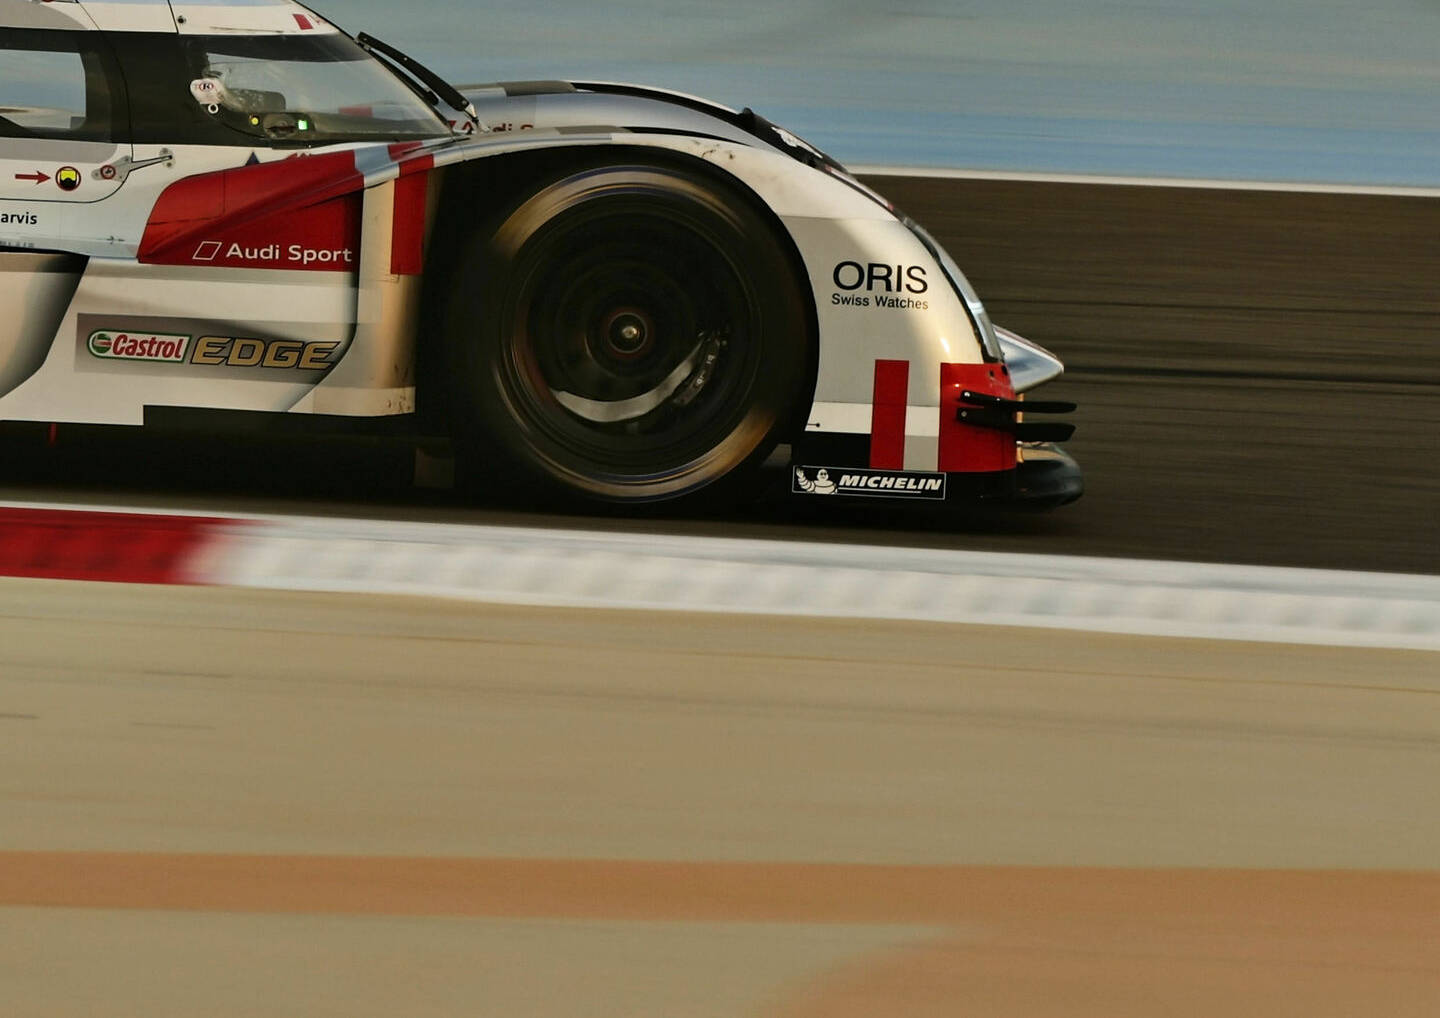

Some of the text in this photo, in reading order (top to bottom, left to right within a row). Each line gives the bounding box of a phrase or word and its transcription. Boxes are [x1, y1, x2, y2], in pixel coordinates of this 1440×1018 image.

[226, 242, 353, 265] Audi Sport
[832, 261, 928, 294] ORIS
[831, 293, 929, 310] Swiss Watches
[112, 334, 342, 370] Castrol EDGE
[839, 474, 942, 491] MICHELIN
